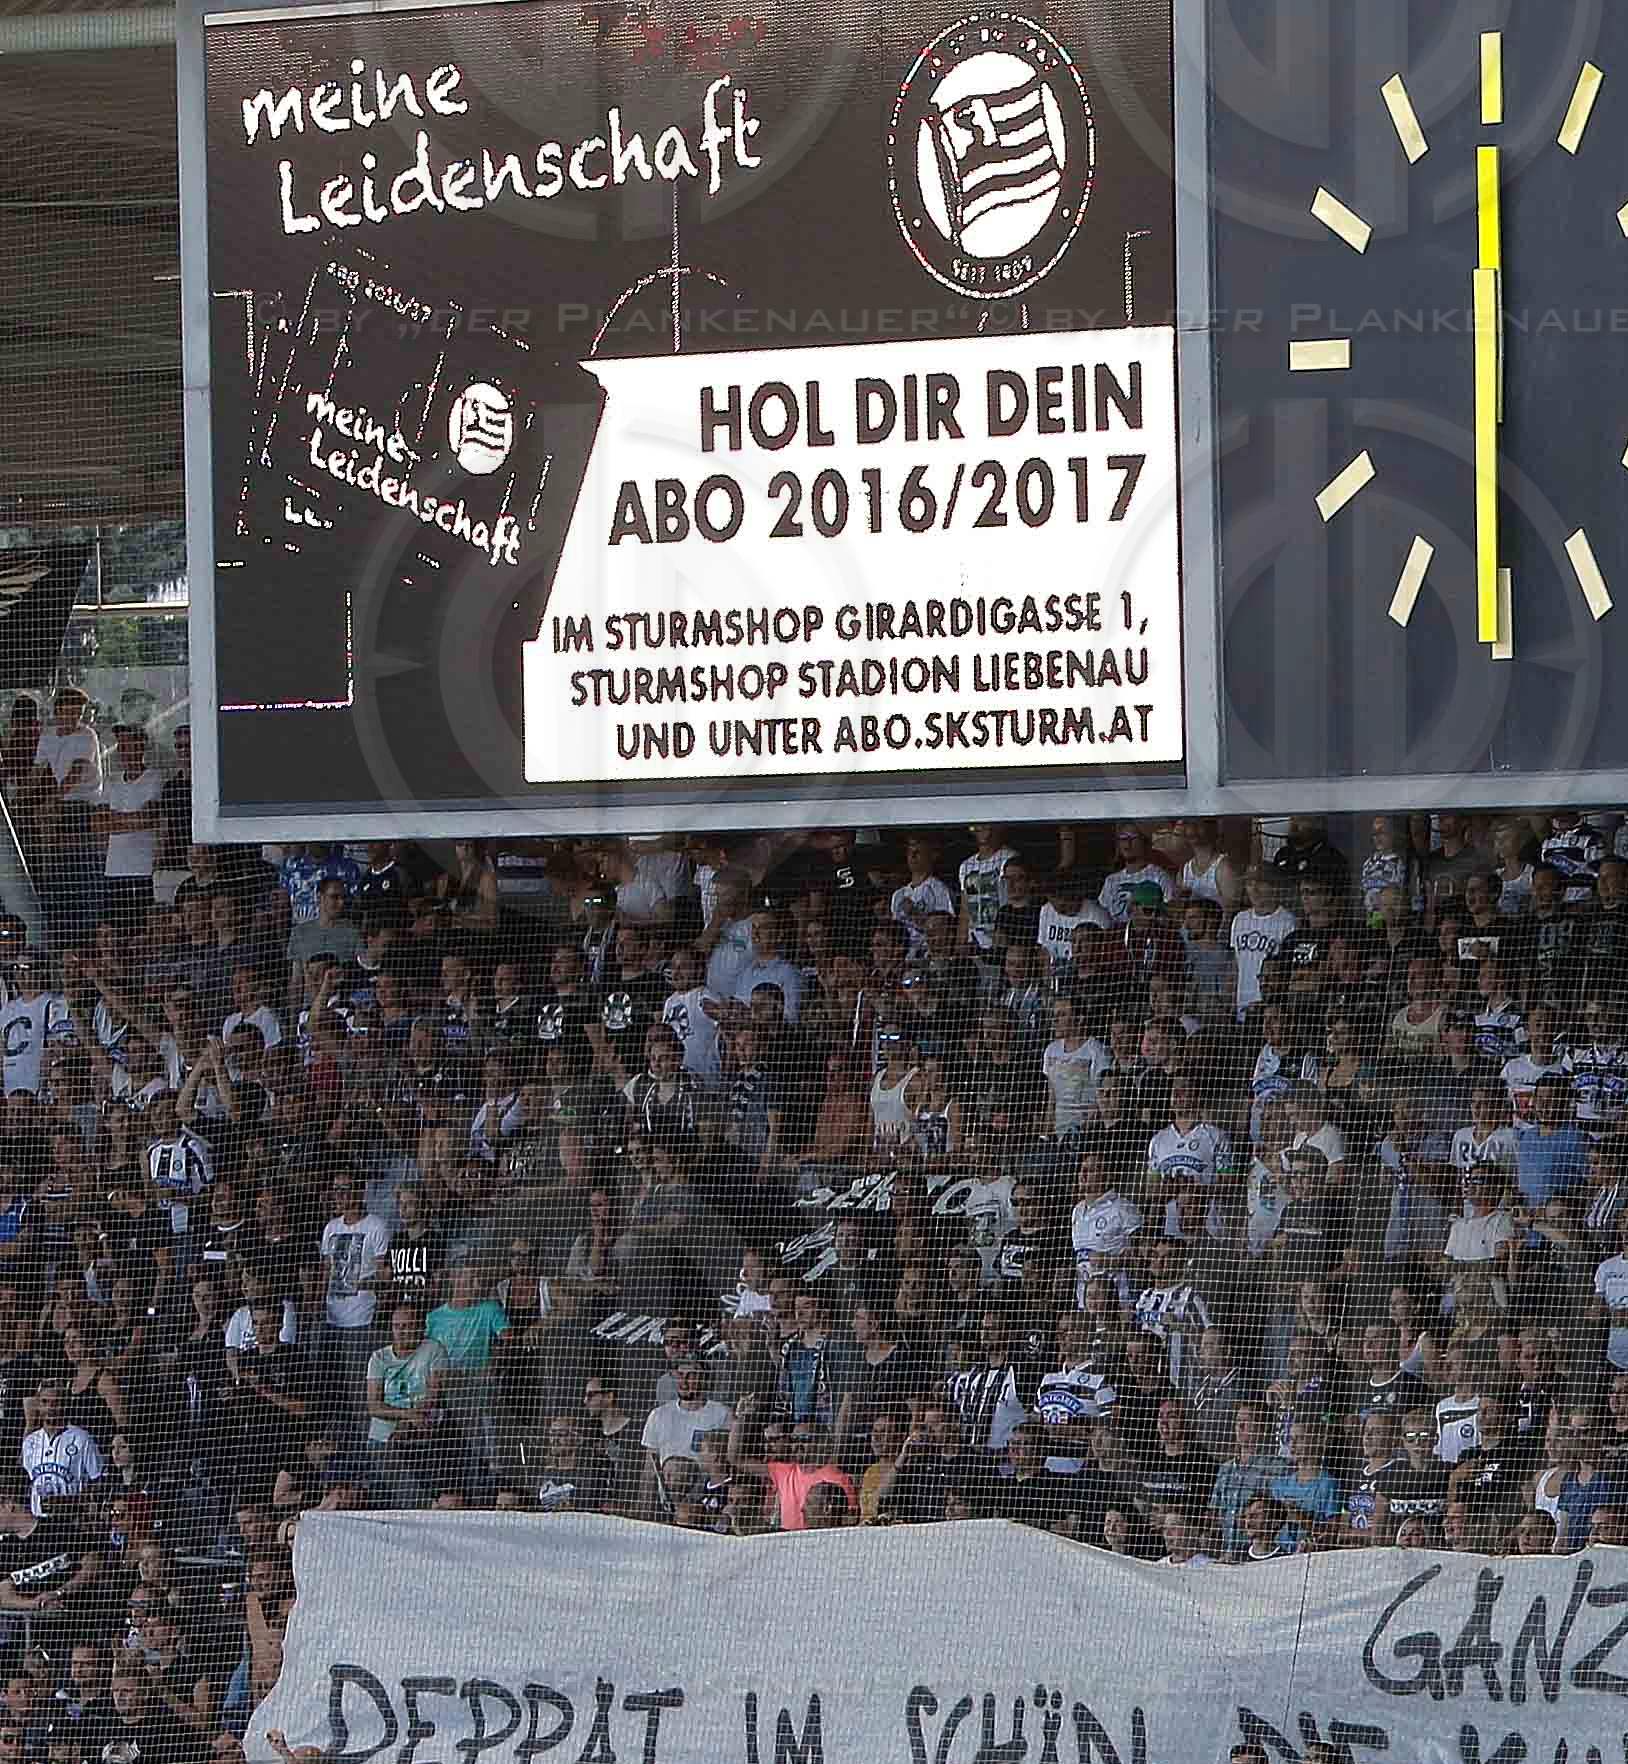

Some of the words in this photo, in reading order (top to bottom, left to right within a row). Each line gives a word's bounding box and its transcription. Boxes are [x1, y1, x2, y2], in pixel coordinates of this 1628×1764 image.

[242, 60, 468, 147] meine
[275, 72, 762, 234] Leidenschaft
[700, 381, 834, 452] HOL
[856, 372, 962, 445] DIR
[987, 361, 1144, 438] DEIN
[306, 425, 521, 568] Leidenschaft
[608, 474, 745, 546] ABO
[766, 453, 1146, 539] 2016/2017
[552, 614, 595, 654] IM
[605, 604, 823, 652] STURMSHOP
[835, 592, 1103, 643] GIRARDIGASSE
[1119, 591, 1149, 637] 1,
[571, 662, 788, 707] STURMSHOP
[798, 655, 960, 698] STADION
[972, 646, 1149, 692] LIEBENAU
[615, 721, 696, 760] UND
[708, 716, 822, 757] UNTER
[833, 703, 1153, 752] ABO.SKSTURM.AT
